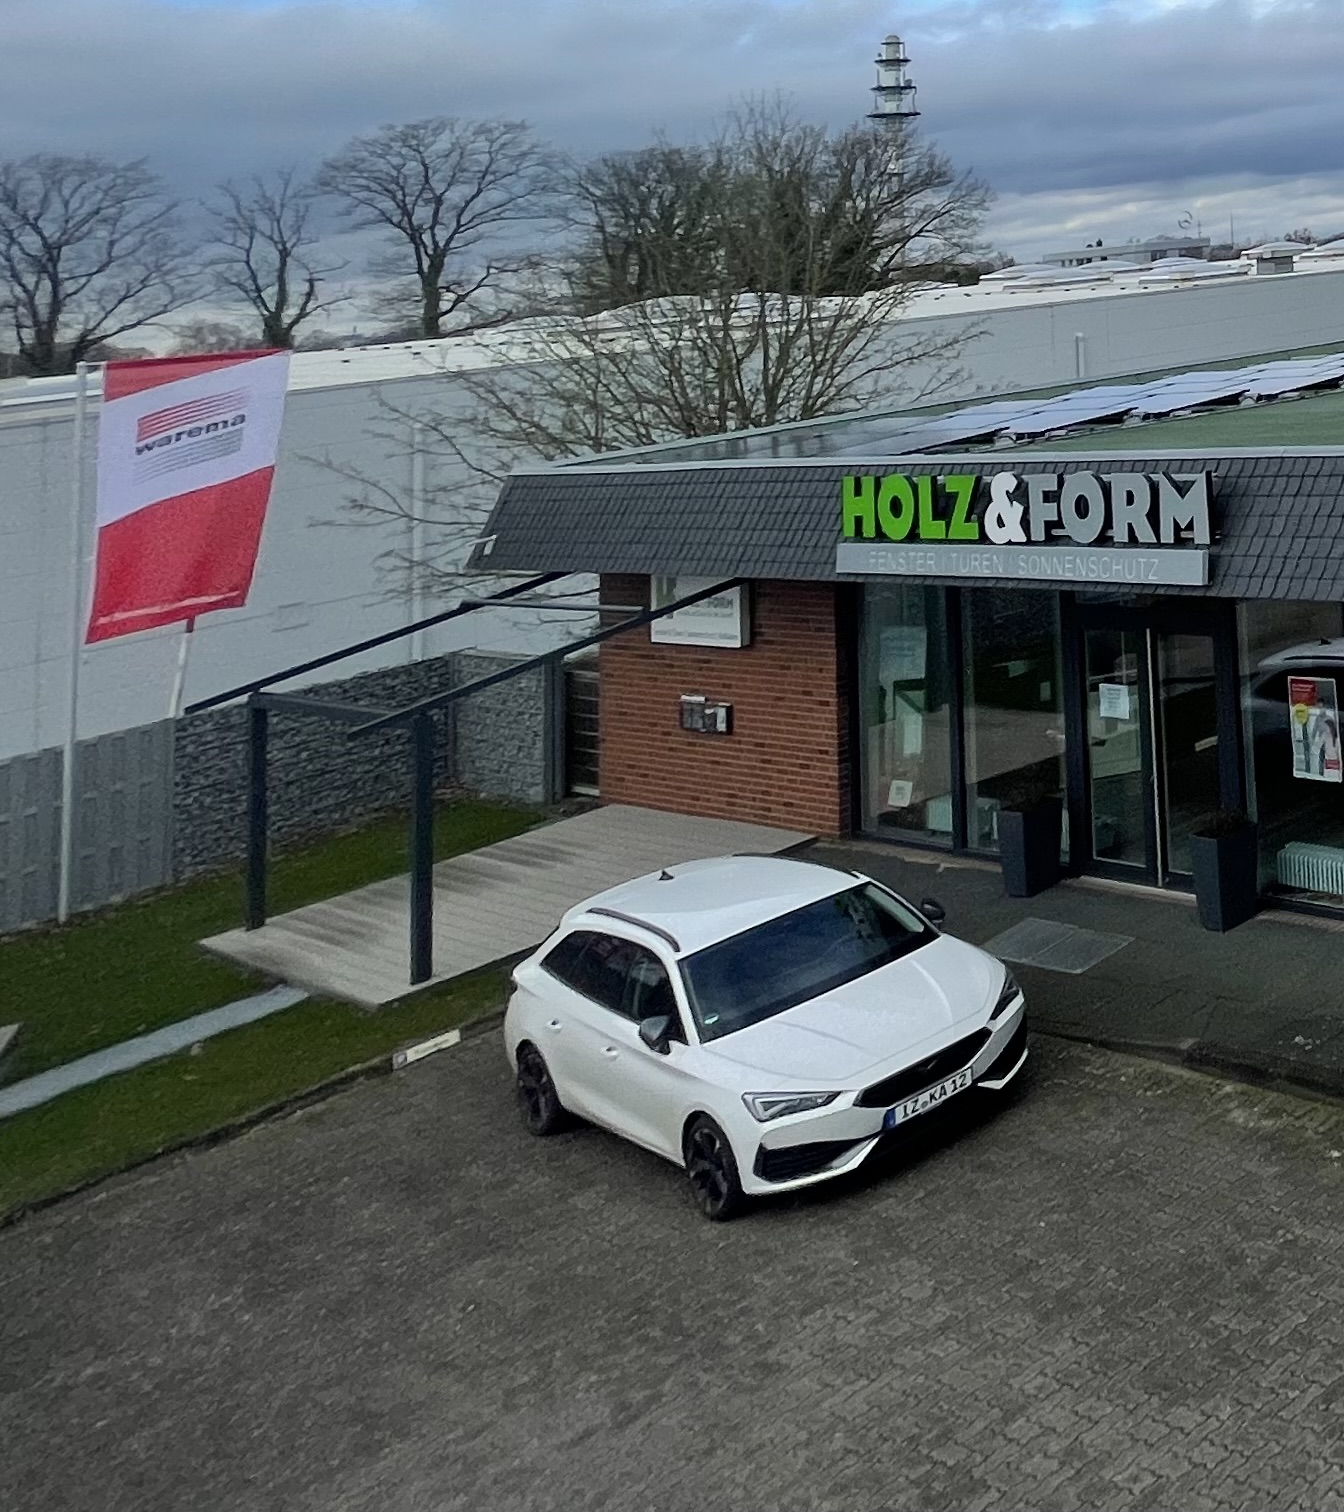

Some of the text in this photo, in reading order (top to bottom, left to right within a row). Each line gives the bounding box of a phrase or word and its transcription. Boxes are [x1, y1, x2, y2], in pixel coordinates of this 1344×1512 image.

[136, 414, 246, 456] warema
[842, 470, 1212, 545] HOLZ&FORM
[868, 550, 938, 573] FENSTER
[1017, 554, 1160, 581] SONNENSCHUTZ
[902, 1073, 968, 1119] IZ KA 12
